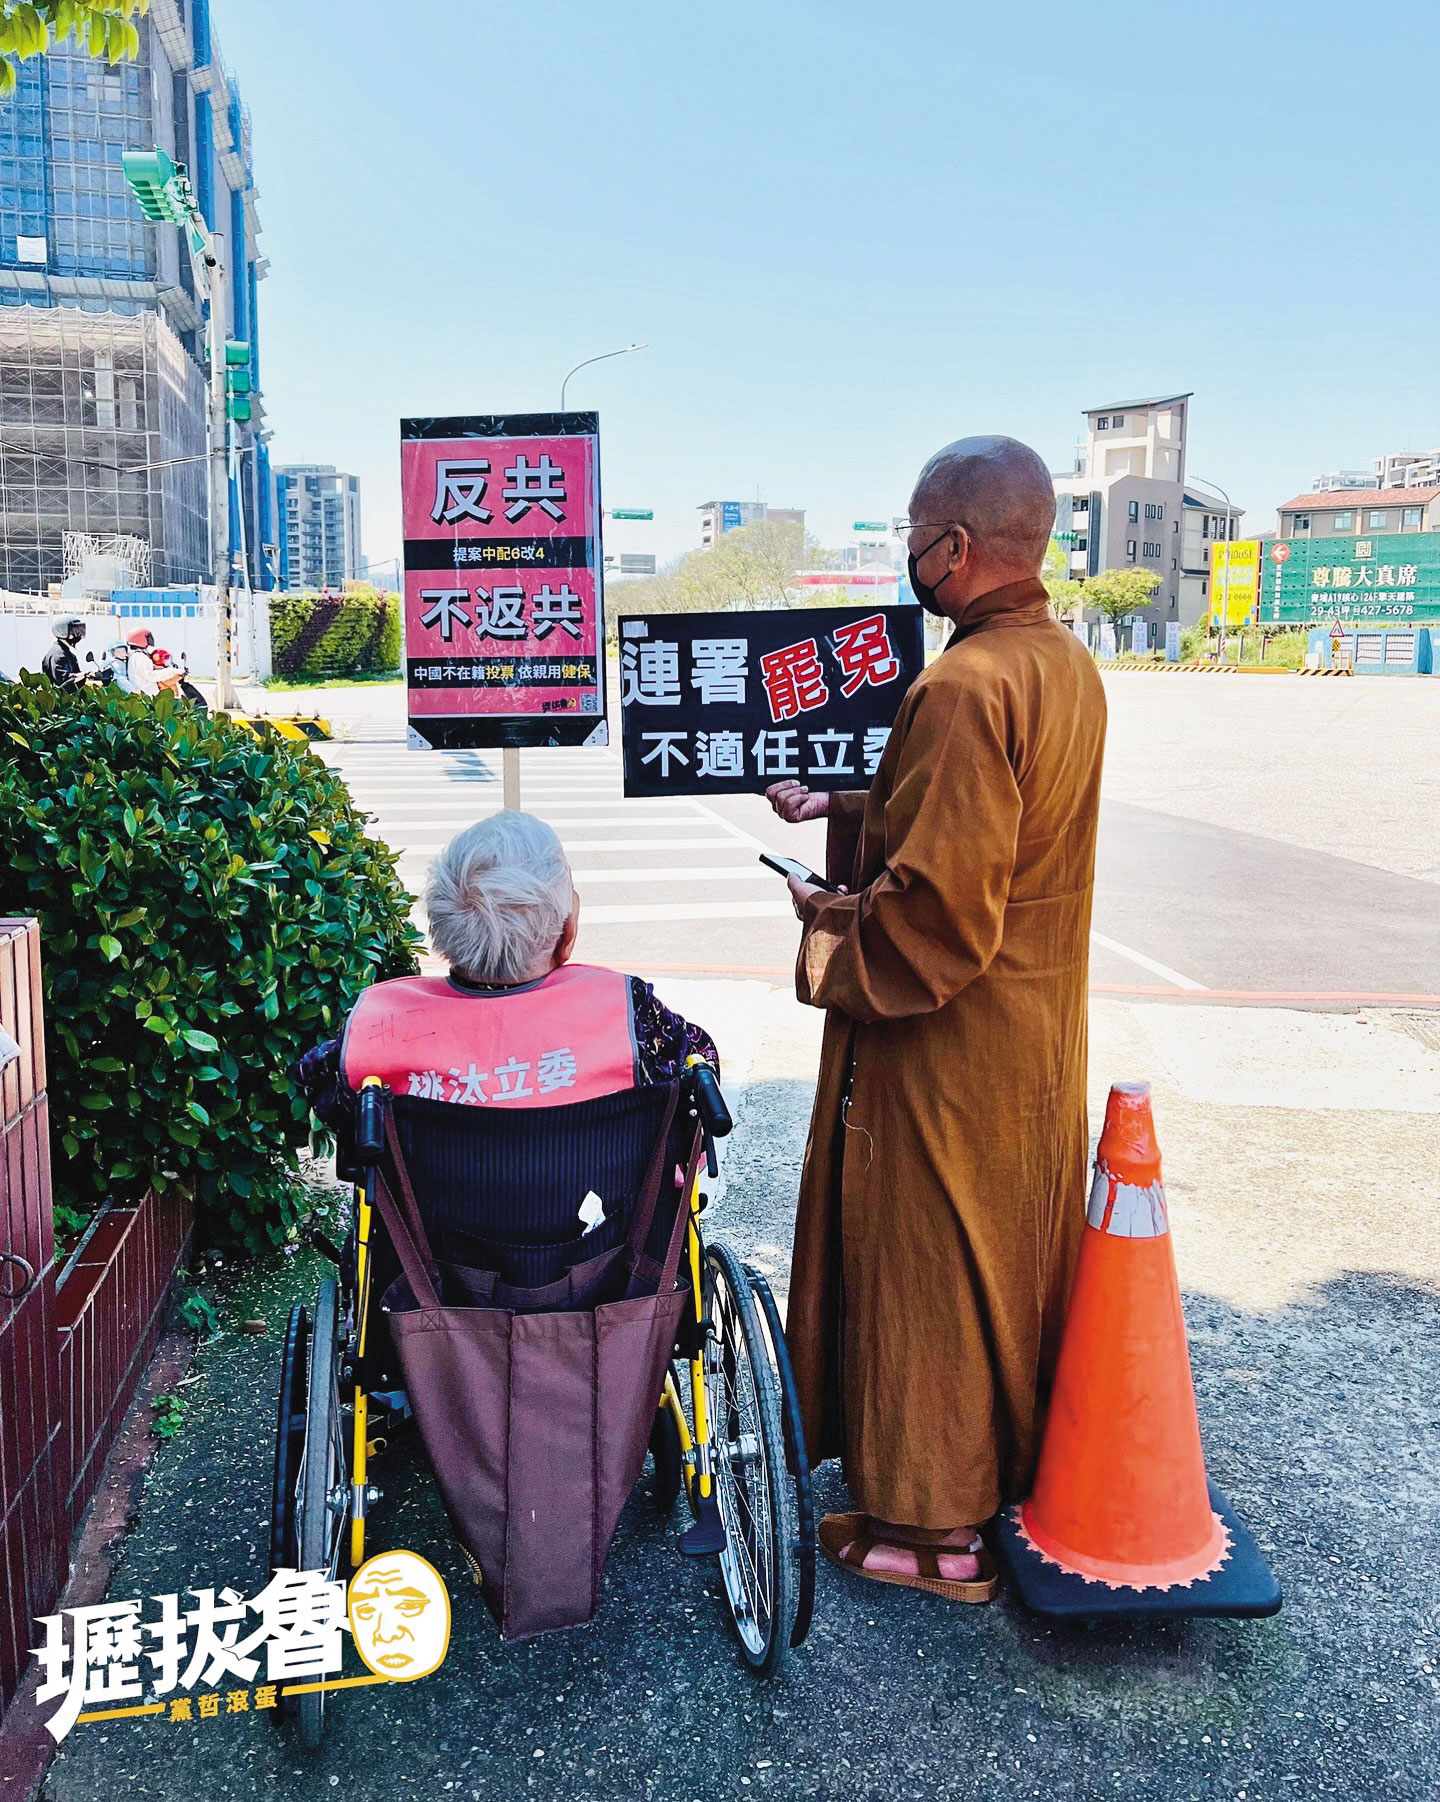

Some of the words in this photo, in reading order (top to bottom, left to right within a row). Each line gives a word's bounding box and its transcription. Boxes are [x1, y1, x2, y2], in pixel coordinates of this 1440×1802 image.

[430, 454, 567, 525] 反共
[453, 545, 545, 561] 提案中配6改4
[419, 584, 583, 642] 不返共
[414, 665, 514, 681] 中國不在籍投票
[518, 664, 591, 680] 依親用健保
[407, 1047, 577, 1104] 桃汰立委
